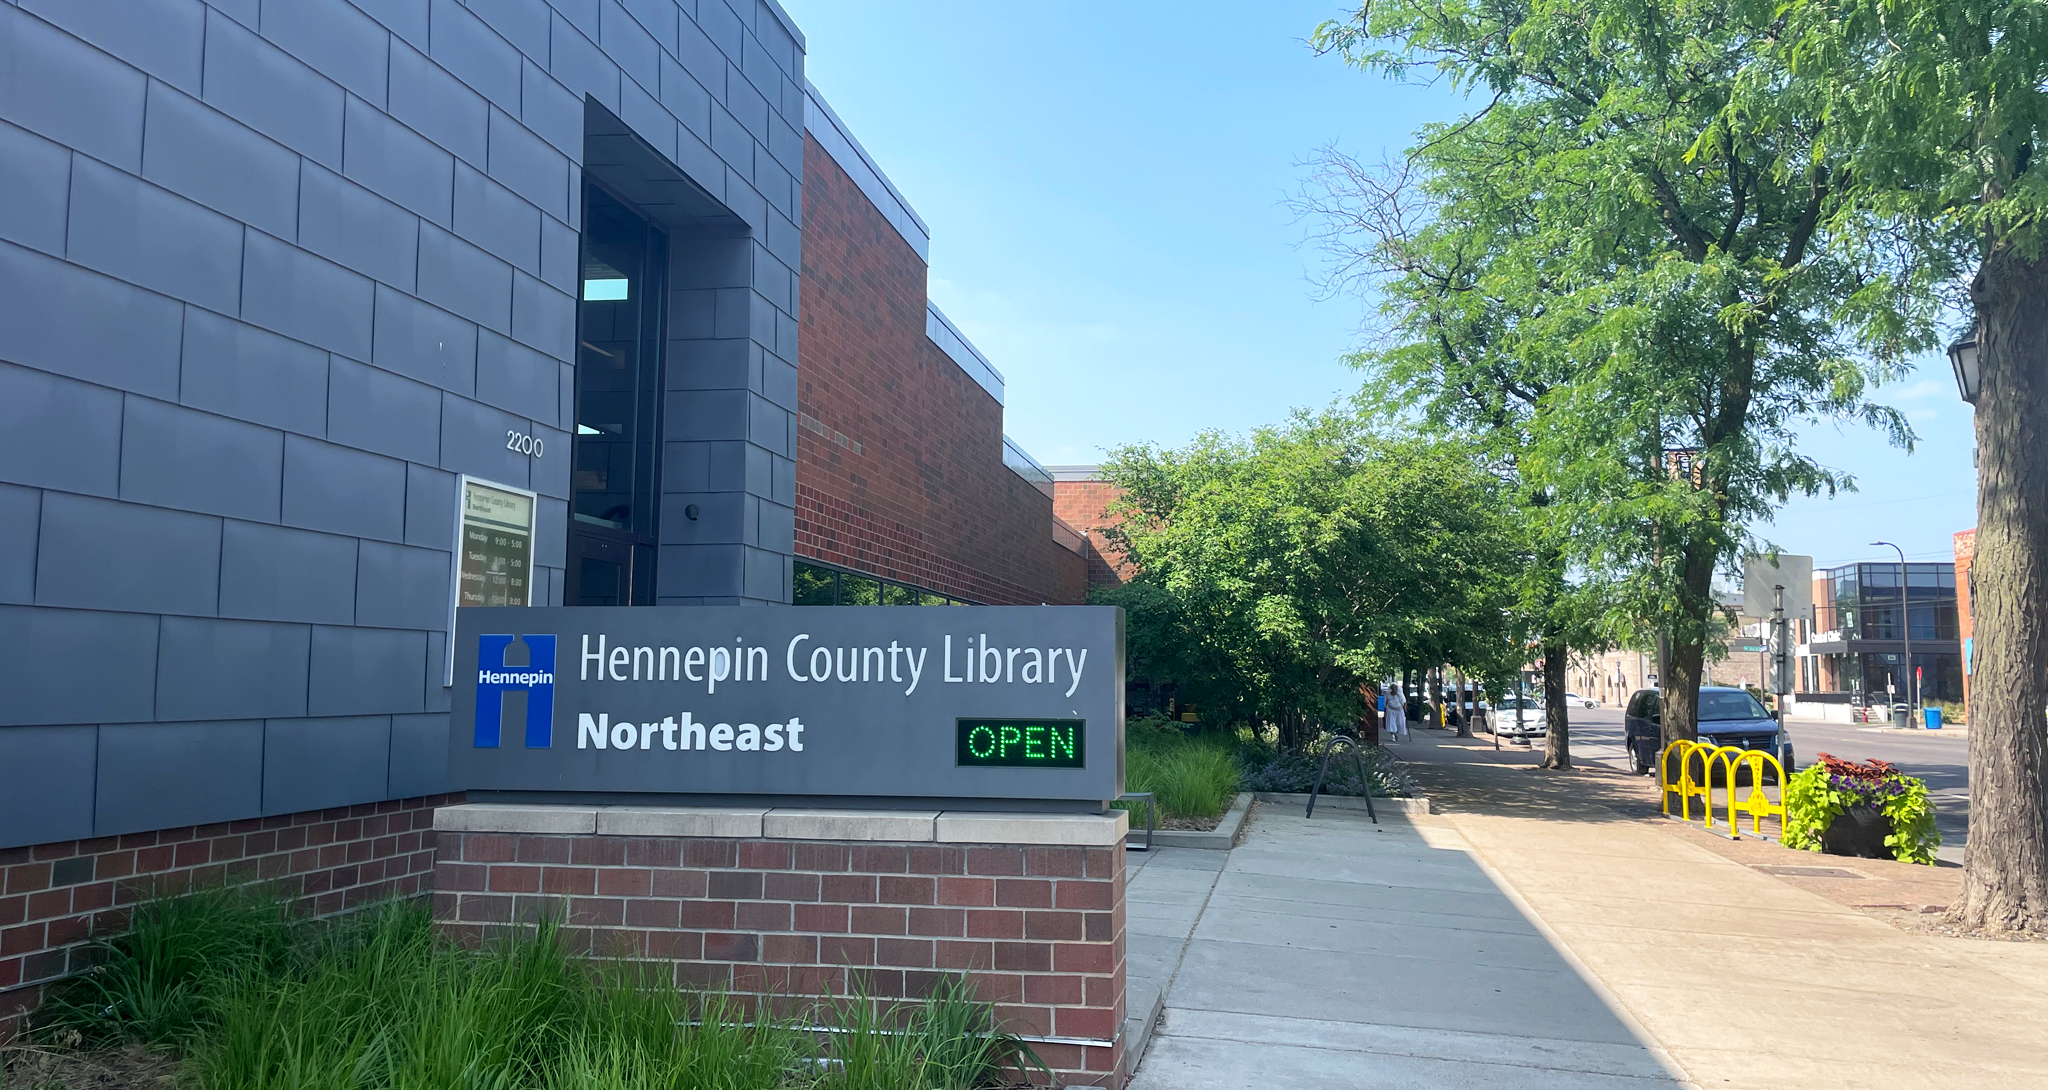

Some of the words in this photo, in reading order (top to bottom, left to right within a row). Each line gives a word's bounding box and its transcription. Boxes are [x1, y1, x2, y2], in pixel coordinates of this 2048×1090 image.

[506, 429, 544, 458] 2200
[469, 531, 488, 543] Monday
[494, 537, 507, 546] 9:00
[511, 540, 522, 549] 5:00
[468, 551, 487, 563] Tuesday
[510, 559, 522, 568] 5:00
[510, 578, 522, 587] 8:00
[464, 591, 485, 603] Thursday
[580, 634, 768, 694] Hennepin
[786, 633, 927, 697] County
[944, 633, 1088, 698] Library
[478, 669, 554, 687] Hennepin
[577, 712, 804, 752] Northeast
[968, 725, 1074, 759] OPEN
